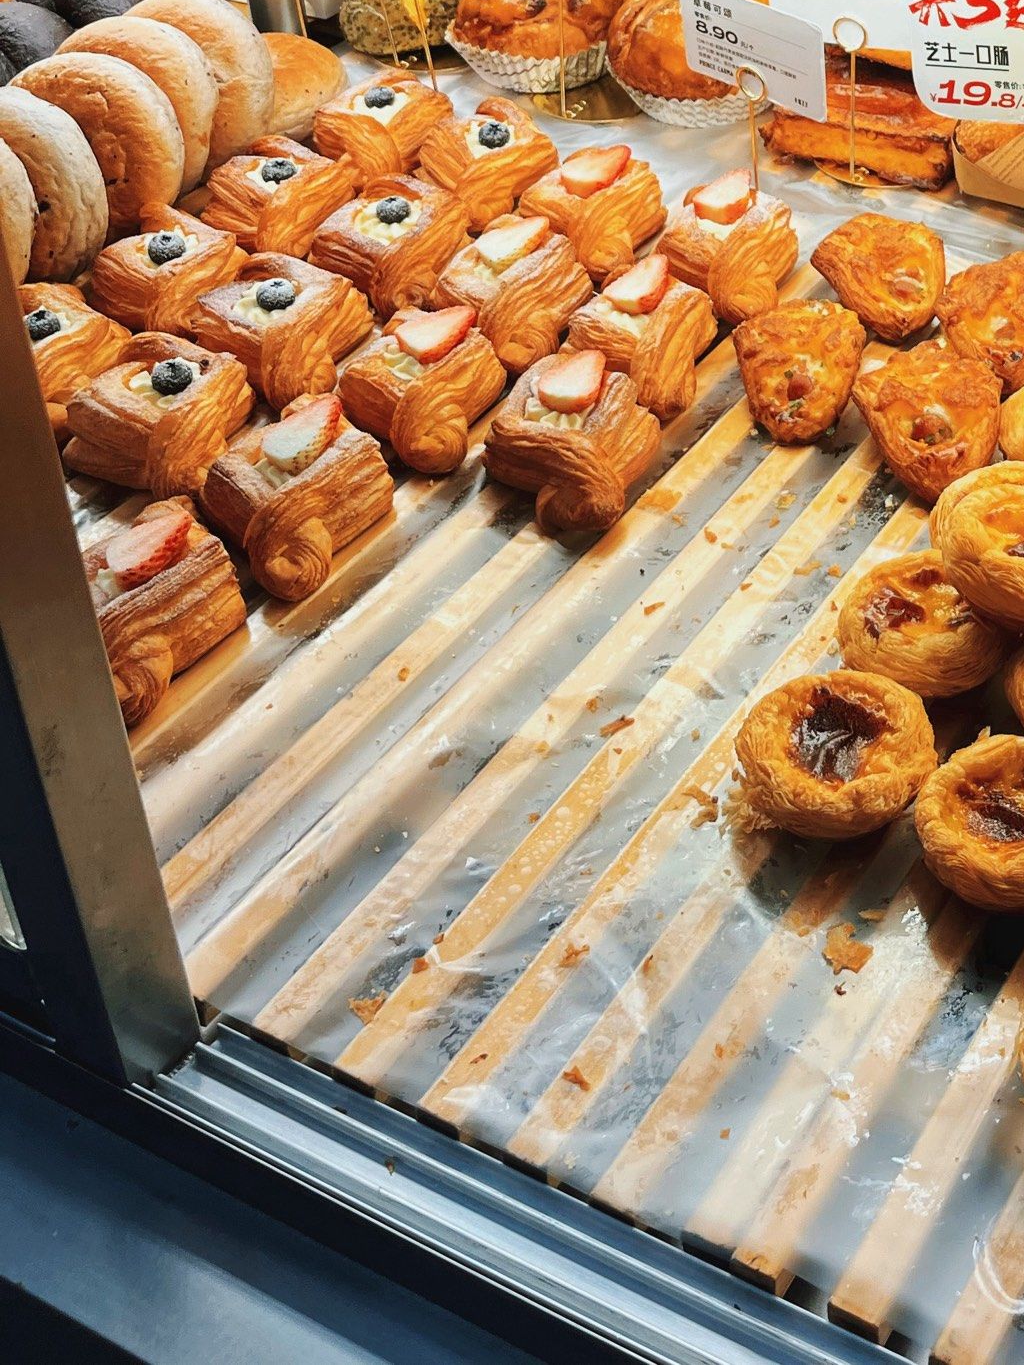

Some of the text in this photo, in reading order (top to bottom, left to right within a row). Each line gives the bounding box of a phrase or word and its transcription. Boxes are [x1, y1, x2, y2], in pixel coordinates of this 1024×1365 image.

[696, 20, 738, 45] 8.90
[924, 41, 1010, 67] 芝士一口肠
